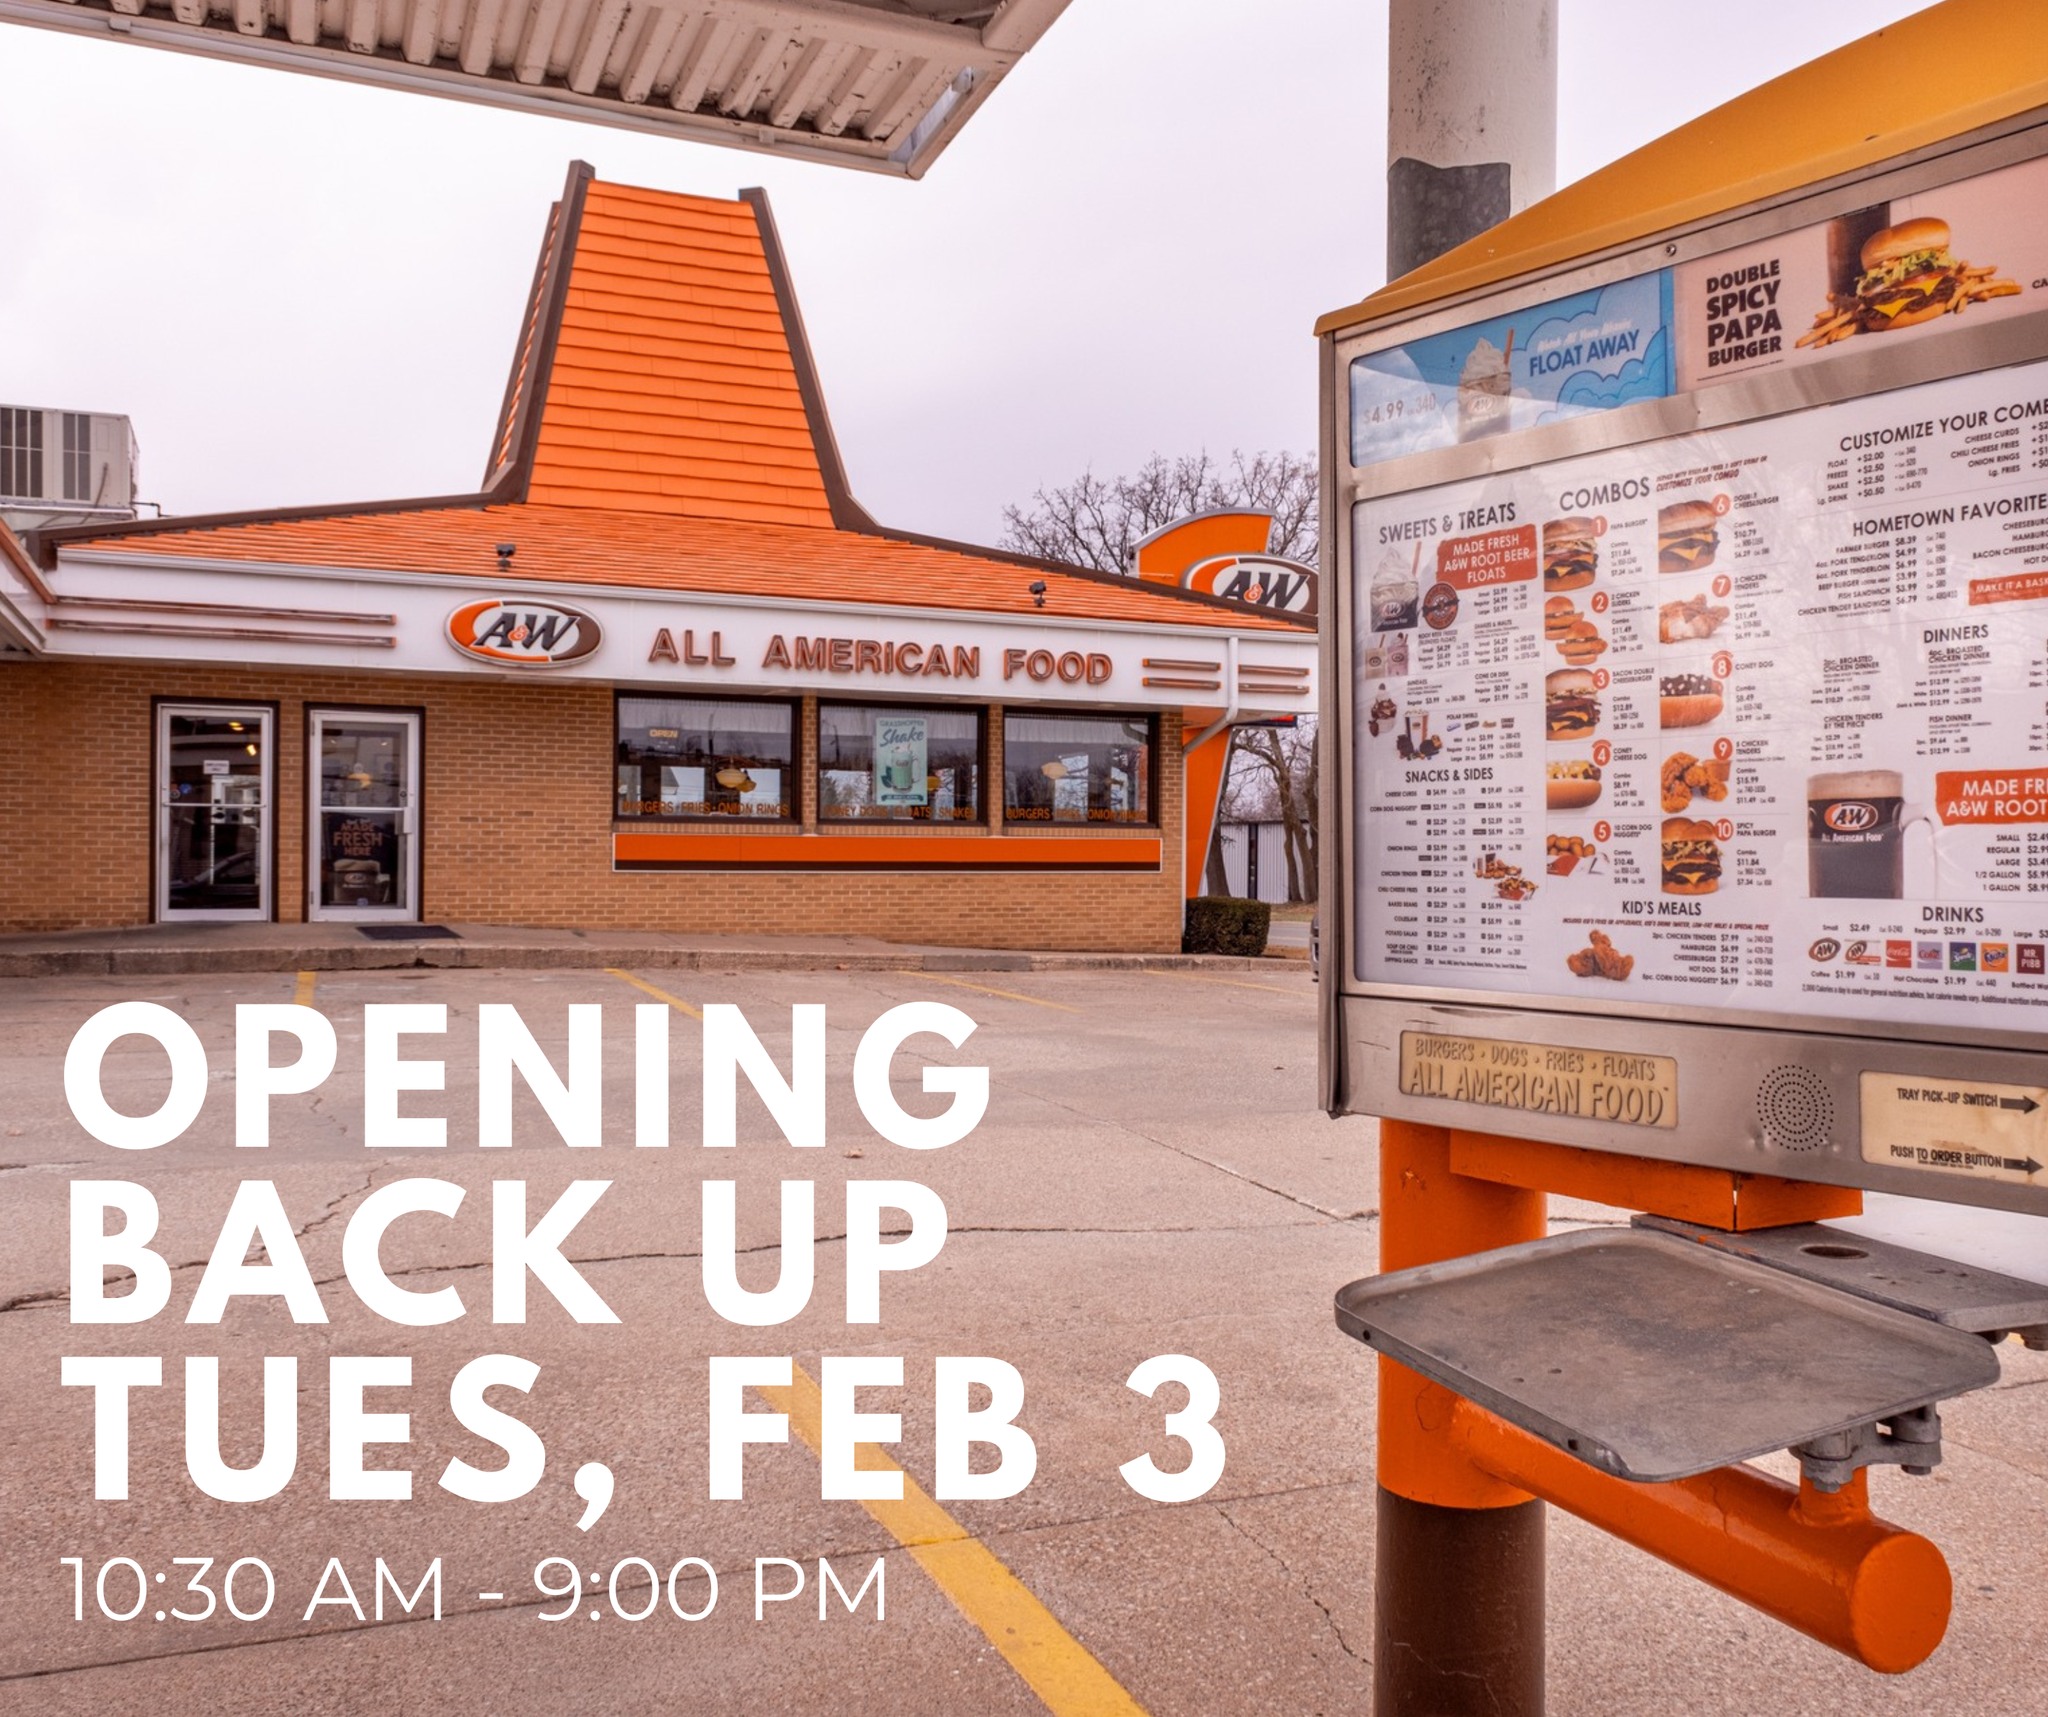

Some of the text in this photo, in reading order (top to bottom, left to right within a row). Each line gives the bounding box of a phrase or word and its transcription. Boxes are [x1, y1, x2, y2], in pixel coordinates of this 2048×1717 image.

[1707, 259, 1780, 294] DOUBLE
[1707, 279, 1781, 320] SPICY
[1708, 308, 1782, 348] PAPA
[1530, 345, 1582, 377] FLOAT
[1587, 329, 1639, 363] AWAY
[1708, 336, 1782, 367] BURGER
[1840, 420, 1933, 452] CUSTOMIZE
[1939, 410, 1987, 433] YOUR
[1965, 428, 2019, 444] CHEESE CURDS
[1951, 441, 2020, 459] CHILI CHEESE FRIES
[1828, 459, 1847, 468] FLOAT
[1968, 453, 2020, 468] ONION RINGS
[1827, 471, 1848, 479] FREEZE
[2001, 465, 2020, 474] FRIES
[1828, 482, 1848, 491] SHAKE
[1559, 477, 1651, 512] COMBOS
[1828, 494, 1847, 502] DRINK
[1717, 499, 1724, 512] 6
[1379, 503, 1516, 544] SWEETS & TREATS
[1595, 519, 1601, 532] 1
[1853, 508, 1955, 537] HOMETOWN
[1453, 534, 1519, 556] MADE FRESH
[1444, 548, 1530, 572] A&W ROOT BEER
[1973, 550, 2001, 559] BACON
[2024, 557, 2039, 565] HOT
[1467, 567, 1506, 584] FLOATS
[1220, 570, 1310, 609] A&W
[1718, 580, 1725, 594] 7
[2016, 581, 2022, 589] A
[1595, 596, 1604, 610] 2
[470, 612, 581, 651] A&W
[1924, 624, 1989, 644] DINNERS
[647, 628, 1112, 685] ALL AMERICAN FOOD
[1718, 661, 1726, 675] 8
[1597, 673, 1605, 686] 3
[650, 729, 679, 738] OPEN
[880, 726, 924, 747] Shake
[1598, 749, 1606, 762] 4
[1719, 742, 1727, 756] 9
[1405, 767, 1494, 783] SNACKS & SIDES
[1963, 778, 2048, 796] MADE FR
[623, 801, 789, 815] BURGERS FRIES ONION RINGS
[1006, 808, 1050, 819] BURGERS
[1088, 809, 1114, 820] ONION
[1946, 799, 2047, 817] A&W ROOT
[1834, 808, 1869, 825] A&W
[341, 823, 374, 831] MADE
[1599, 824, 1606, 839] 5
[1717, 823, 1731, 837] 10
[333, 832, 382, 846] FRESH
[344, 847, 372, 856] HERE
[1622, 900, 1702, 916] KID'S MEALS
[1922, 906, 1984, 923] DRINKS
[1850, 924, 1870, 932] $2.49
[1944, 927, 1966, 935] $2.99
[2013, 930, 2033, 938] Large
[1673, 954, 1716, 962] CHEESEBURGER
[1835, 970, 1855, 979] $1.99
[1944, 977, 1966, 985] $1.99
[1415, 1039, 1655, 1081] BURGERS DOGS FRIES FLOATS
[1410, 1061, 1448, 1097] ALL
[1455, 1066, 1580, 1115] AMERICAN
[1897, 1088, 1998, 1107] TRAY PICK-UP SWITCH
[1890, 1144, 1914, 1158] PUSH
[1916, 1148, 1928, 1160] TO
[1931, 1150, 1962, 1164] ORDER
[1965, 1153, 2002, 1167] BUTTON
